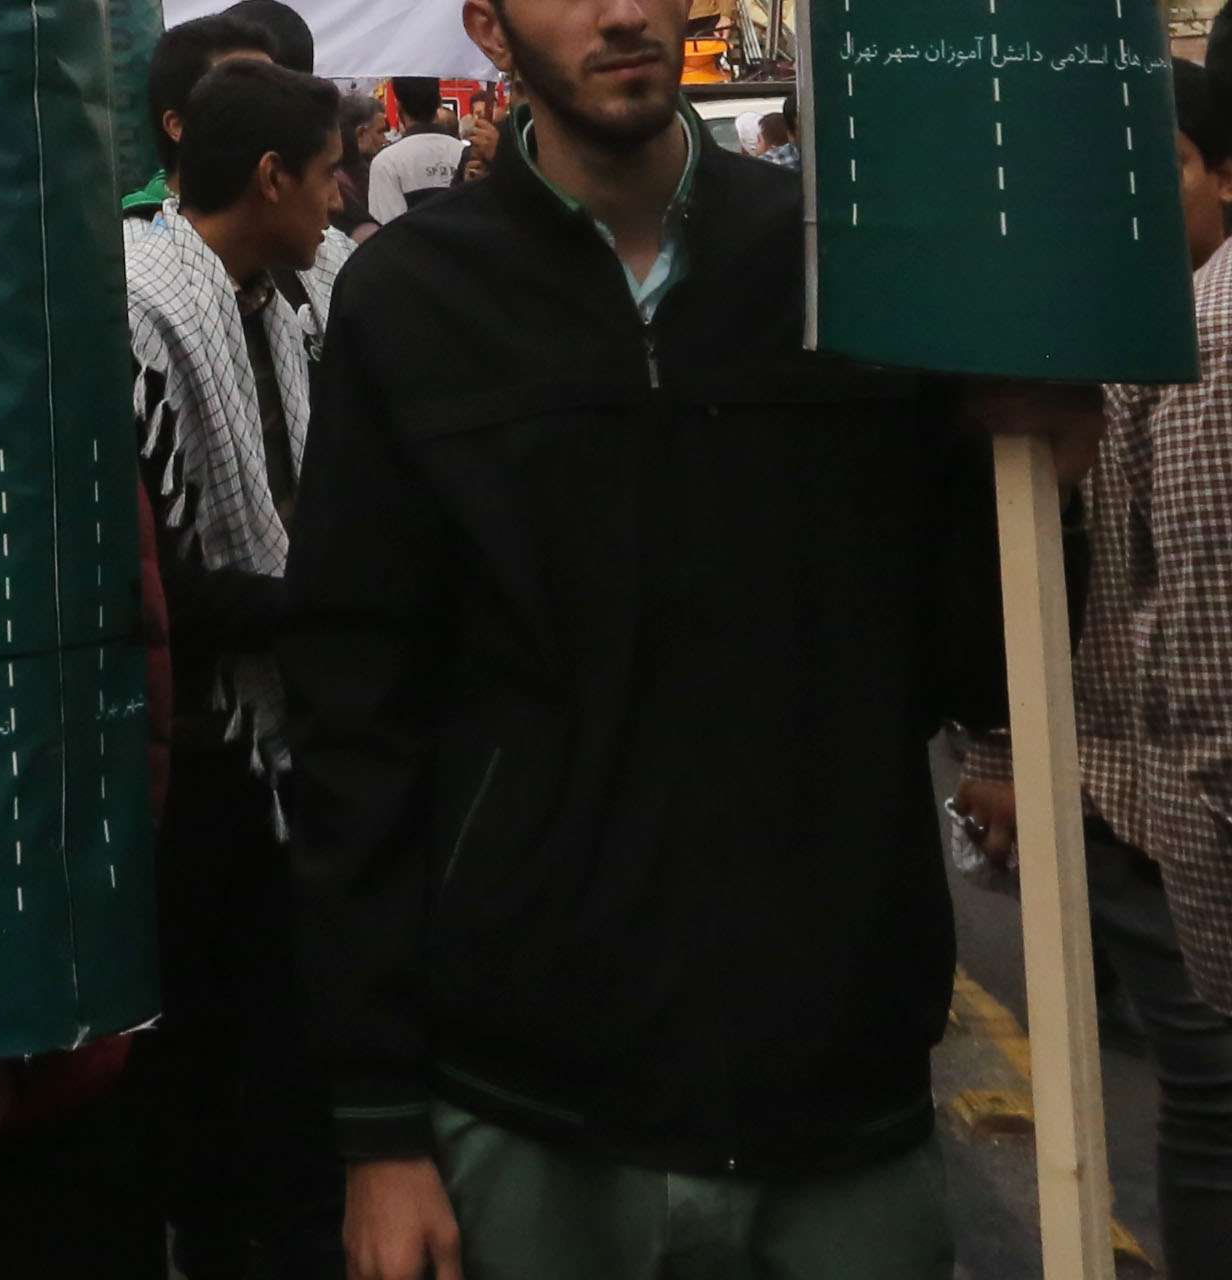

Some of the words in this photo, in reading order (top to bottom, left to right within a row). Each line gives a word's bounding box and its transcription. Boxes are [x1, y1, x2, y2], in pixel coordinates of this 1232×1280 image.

[840, 39, 879, 65] تهران
[883, 42, 921, 66] شهر
[924, 36, 985, 69] آموزان
[991, 41, 1044, 69] دانش
[1050, 43, 1108, 71] اسلامی
